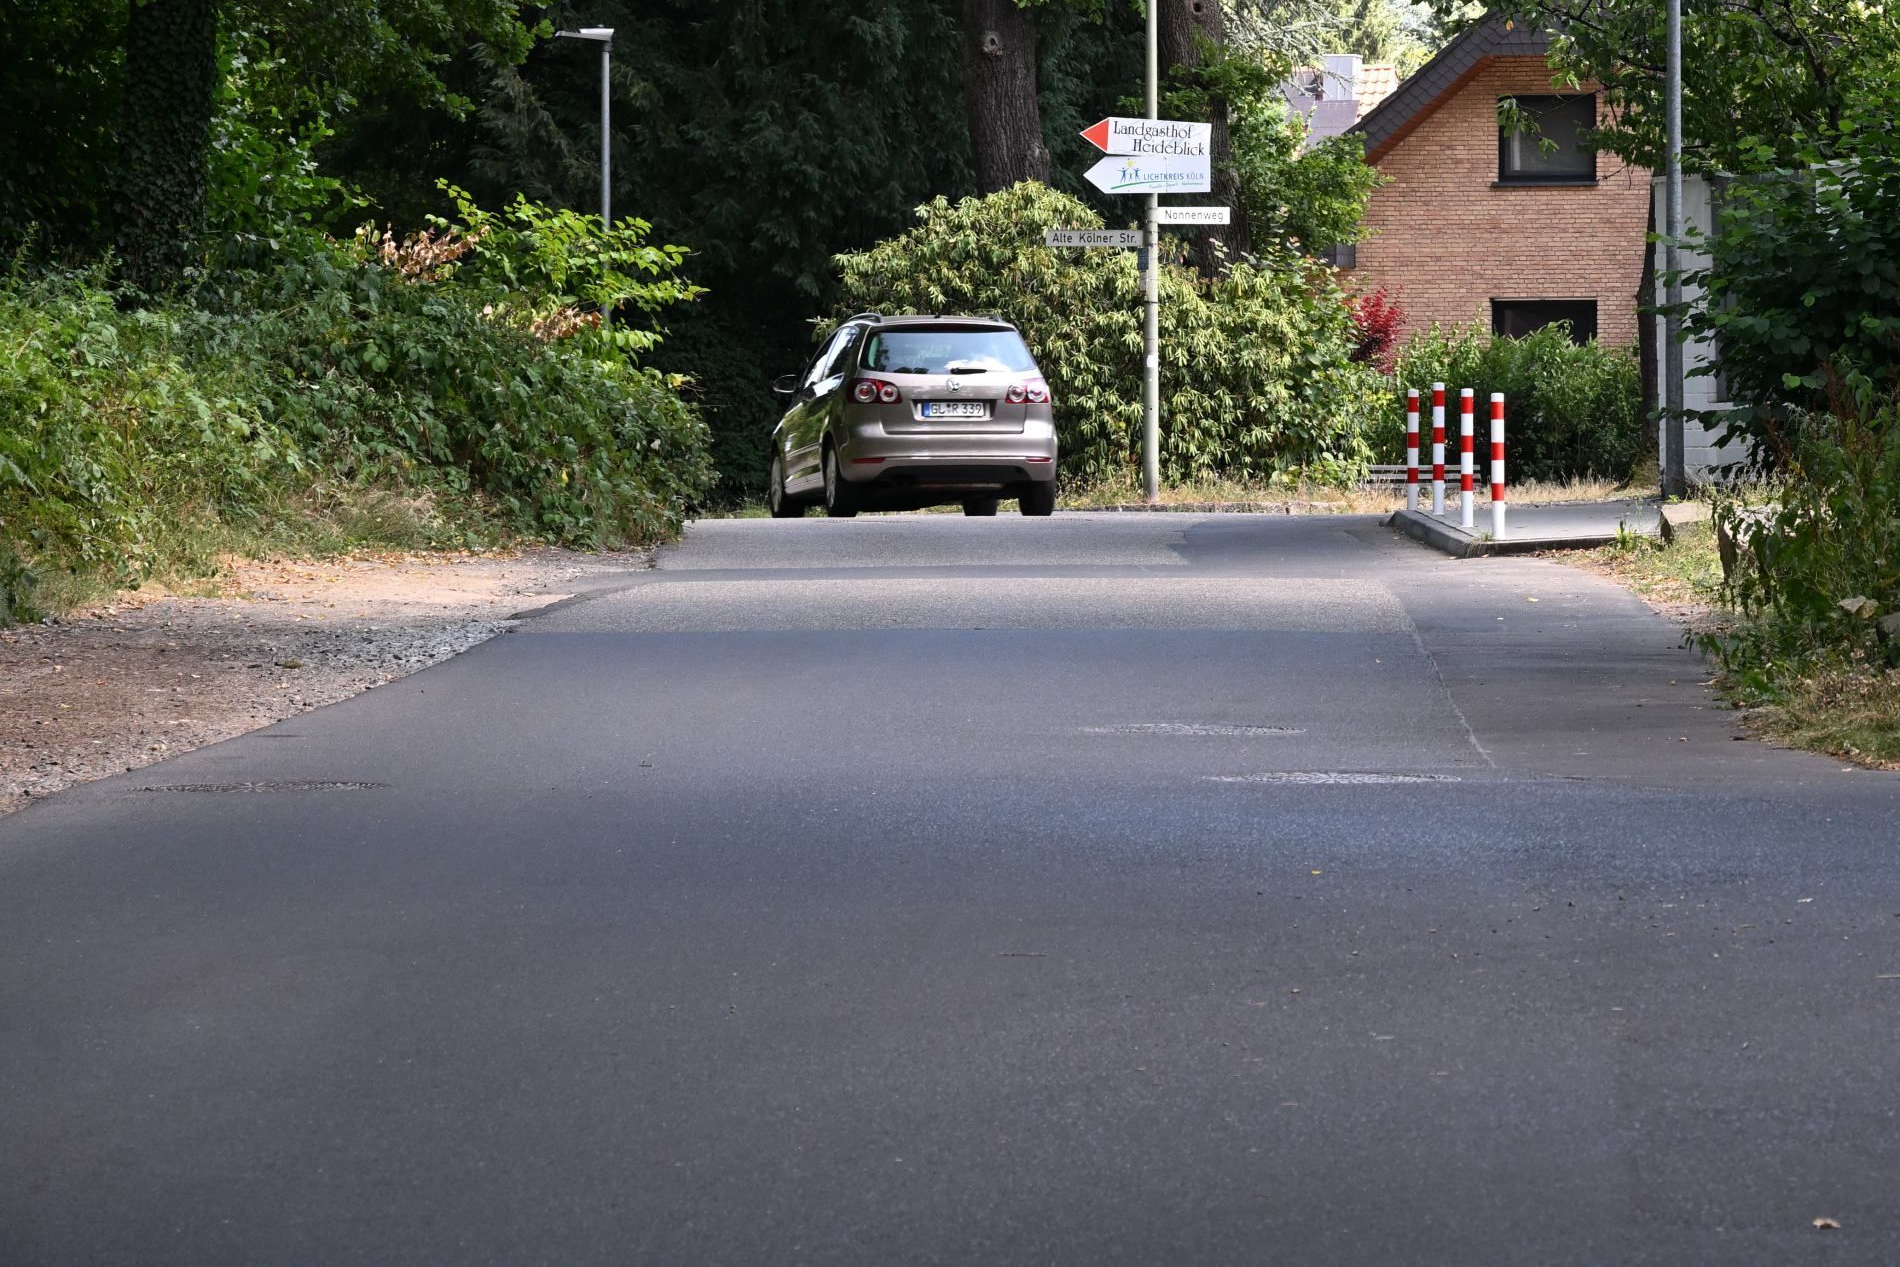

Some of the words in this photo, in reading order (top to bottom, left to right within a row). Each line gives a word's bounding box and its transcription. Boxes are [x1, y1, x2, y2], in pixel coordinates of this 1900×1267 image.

[1113, 120, 1194, 141] Landgasthof
[1132, 138, 1205, 156] Heideblick
[1143, 172, 1184, 181] LICHTKREIS
[1186, 171, 1204, 181] KÖLN
[1165, 209, 1224, 223] Nonnenweg
[1052, 232, 1073, 244] Alte
[1079, 231, 1114, 244] Kölner
[1119, 232, 1137, 244] Str.
[931, 403, 945, 414] GL
[952, 403, 959, 414] R
[961, 403, 982, 414] 339
